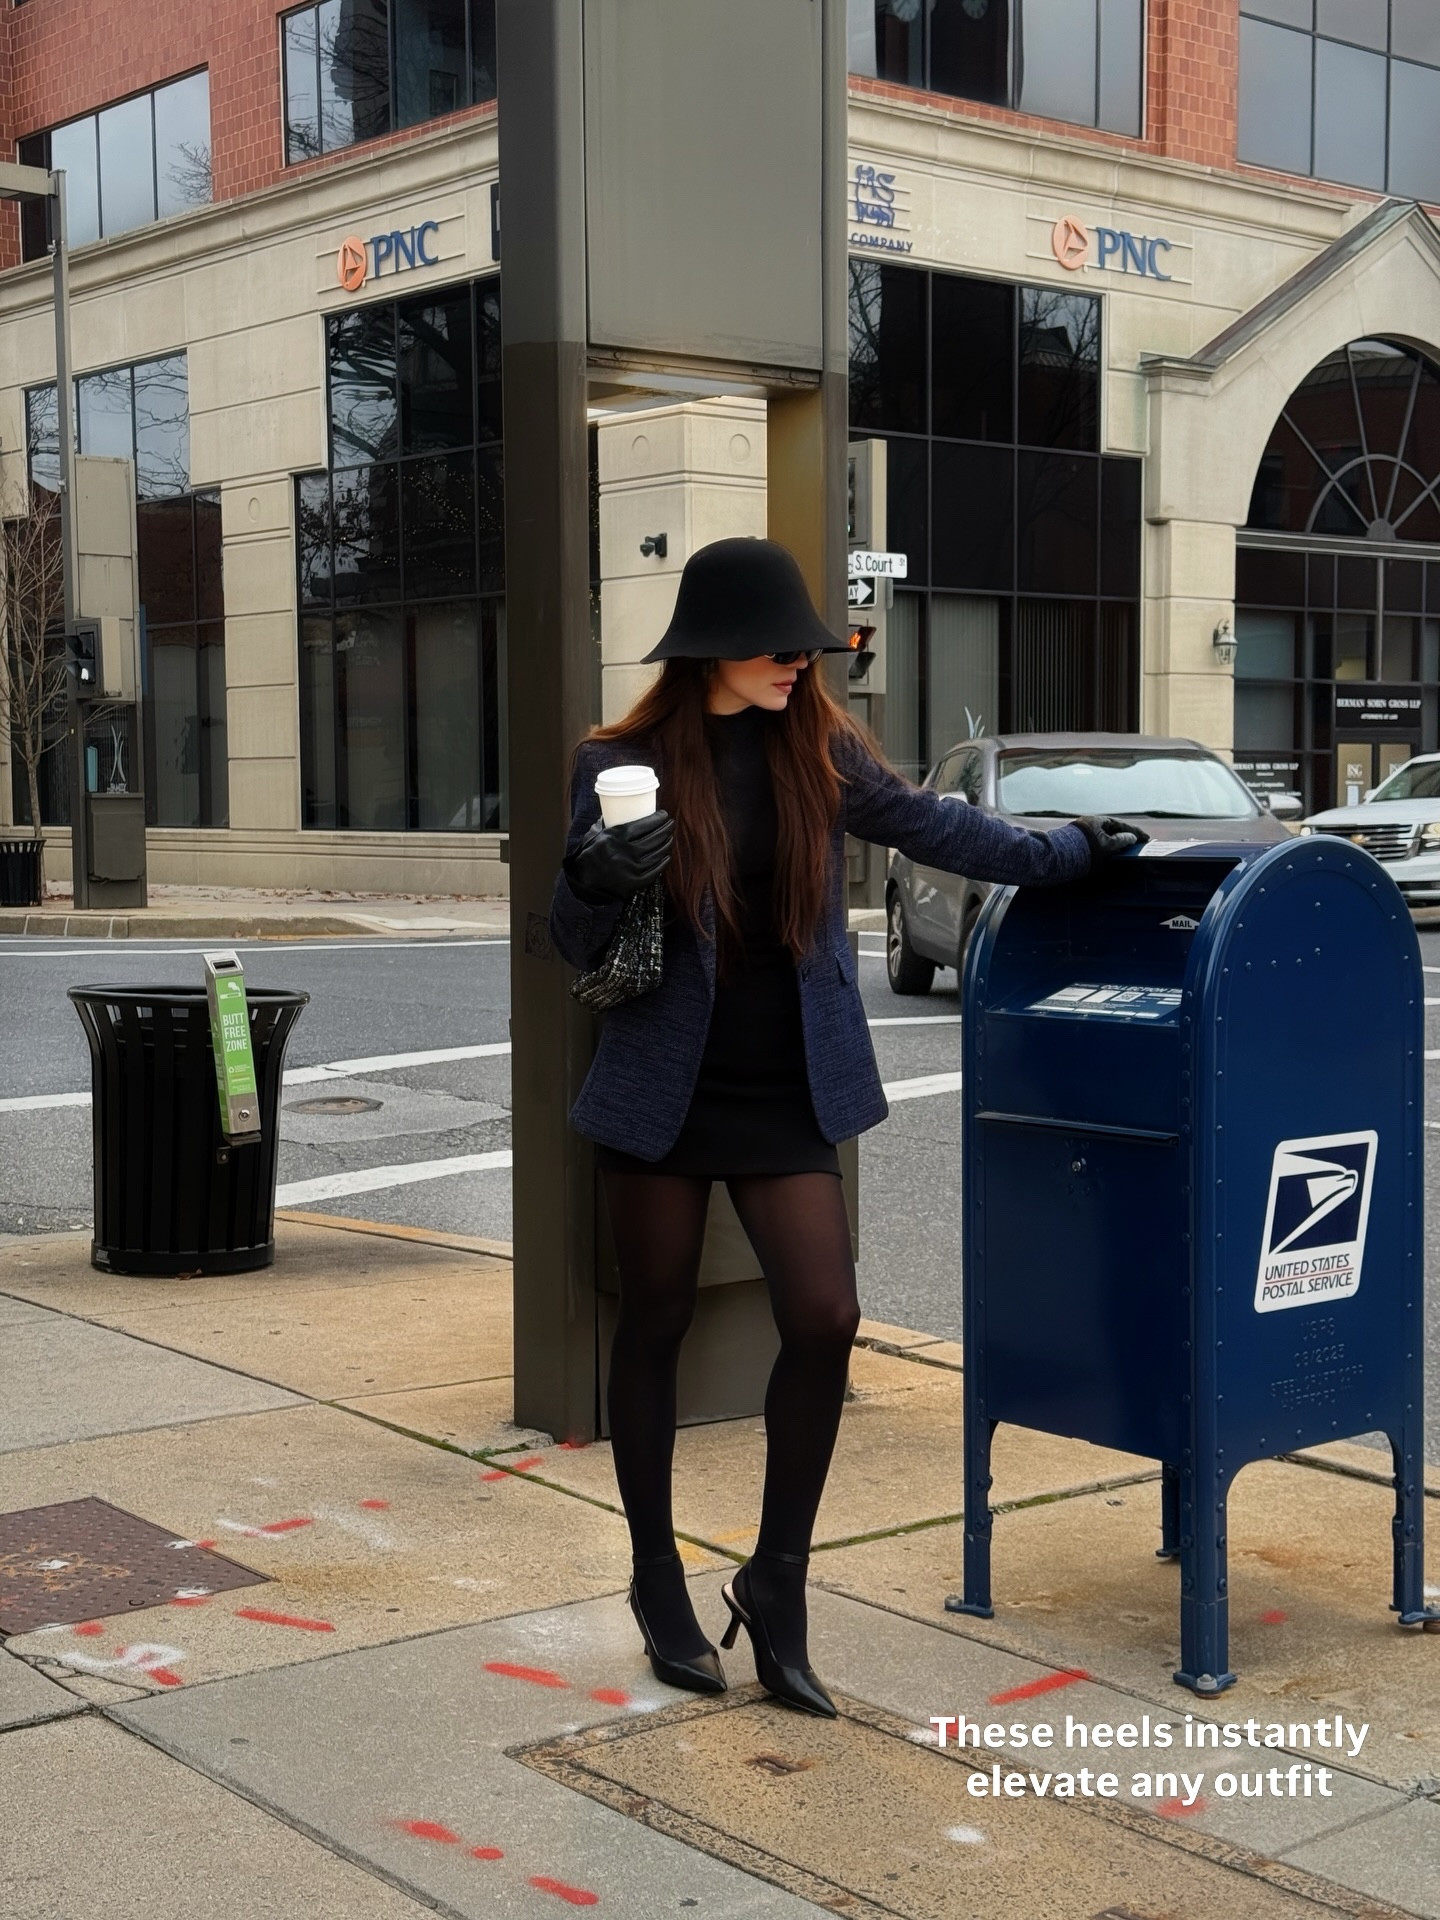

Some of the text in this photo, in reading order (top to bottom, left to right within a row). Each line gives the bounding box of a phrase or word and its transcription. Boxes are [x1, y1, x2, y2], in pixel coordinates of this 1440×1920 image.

[370, 220, 439, 279] PNC
[851, 232, 913, 253] COMPANY
[1096, 227, 1172, 281] PNC
[865, 555, 893, 573] Court
[849, 587, 859, 598] AY
[1171, 920, 1192, 928] MAIL
[222, 1012, 244, 1026] BUTT
[224, 1025, 247, 1039] FREE
[226, 1039, 248, 1053] ZONE
[1265, 1253, 1350, 1281] UNITED STATES
[1262, 1280, 1305, 1301] POSTAL
